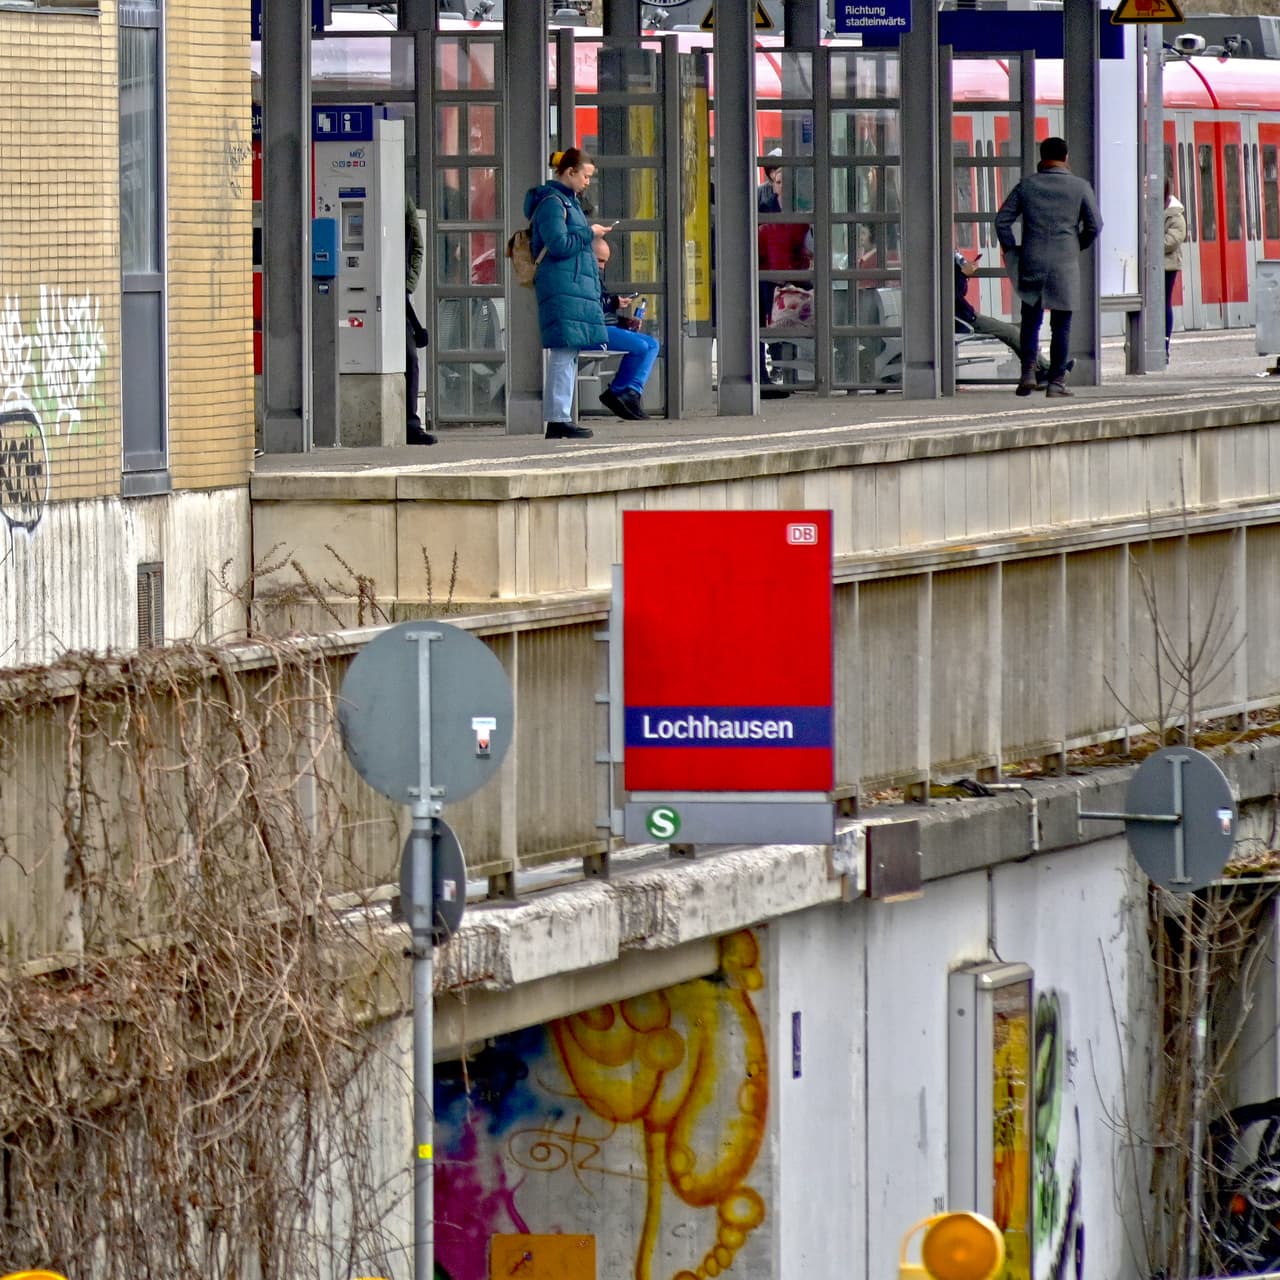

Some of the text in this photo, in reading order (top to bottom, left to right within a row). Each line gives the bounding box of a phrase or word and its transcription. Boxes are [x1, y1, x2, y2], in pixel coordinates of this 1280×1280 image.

[844, 5, 886, 17] Richtung
[845, 16, 907, 27] stadteinwärts
[791, 526, 815, 542] DB
[642, 714, 794, 740] Lochhausen
[650, 808, 676, 838] S
